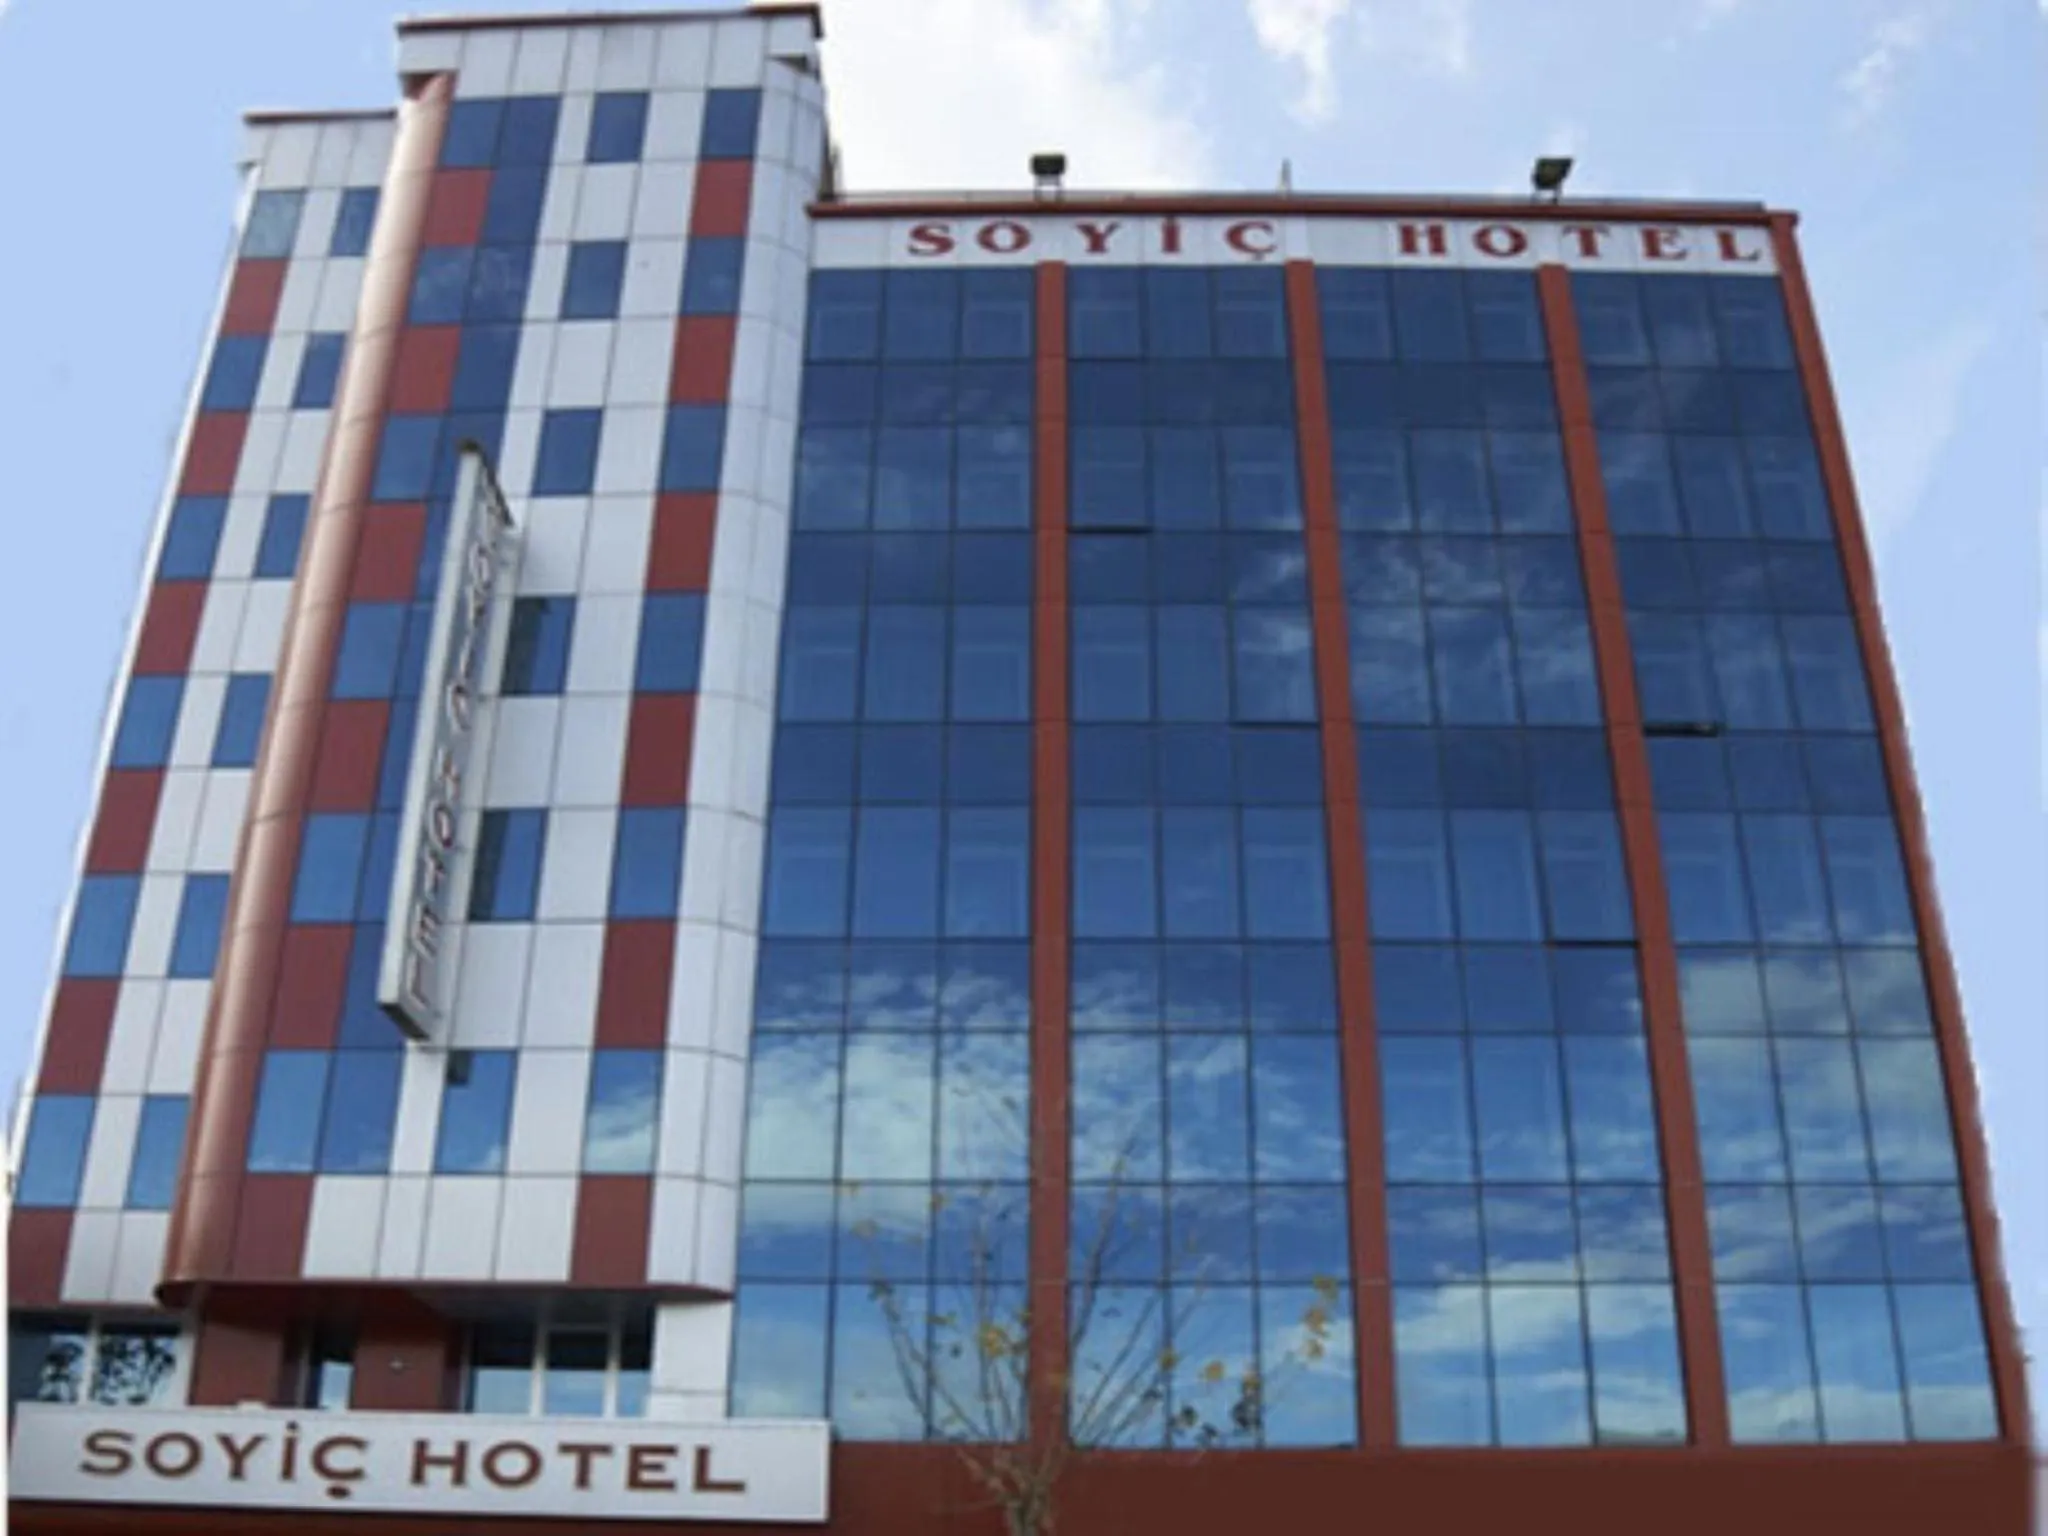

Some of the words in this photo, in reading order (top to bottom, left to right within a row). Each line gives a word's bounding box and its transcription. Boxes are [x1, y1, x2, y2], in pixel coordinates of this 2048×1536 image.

[907, 216, 1277, 260] SOYİÇ
[1400, 222, 1761, 263] HOTEL
[80, 1420, 369, 1499] SOYİÇ
[410, 1438, 747, 1493] HOTEL
